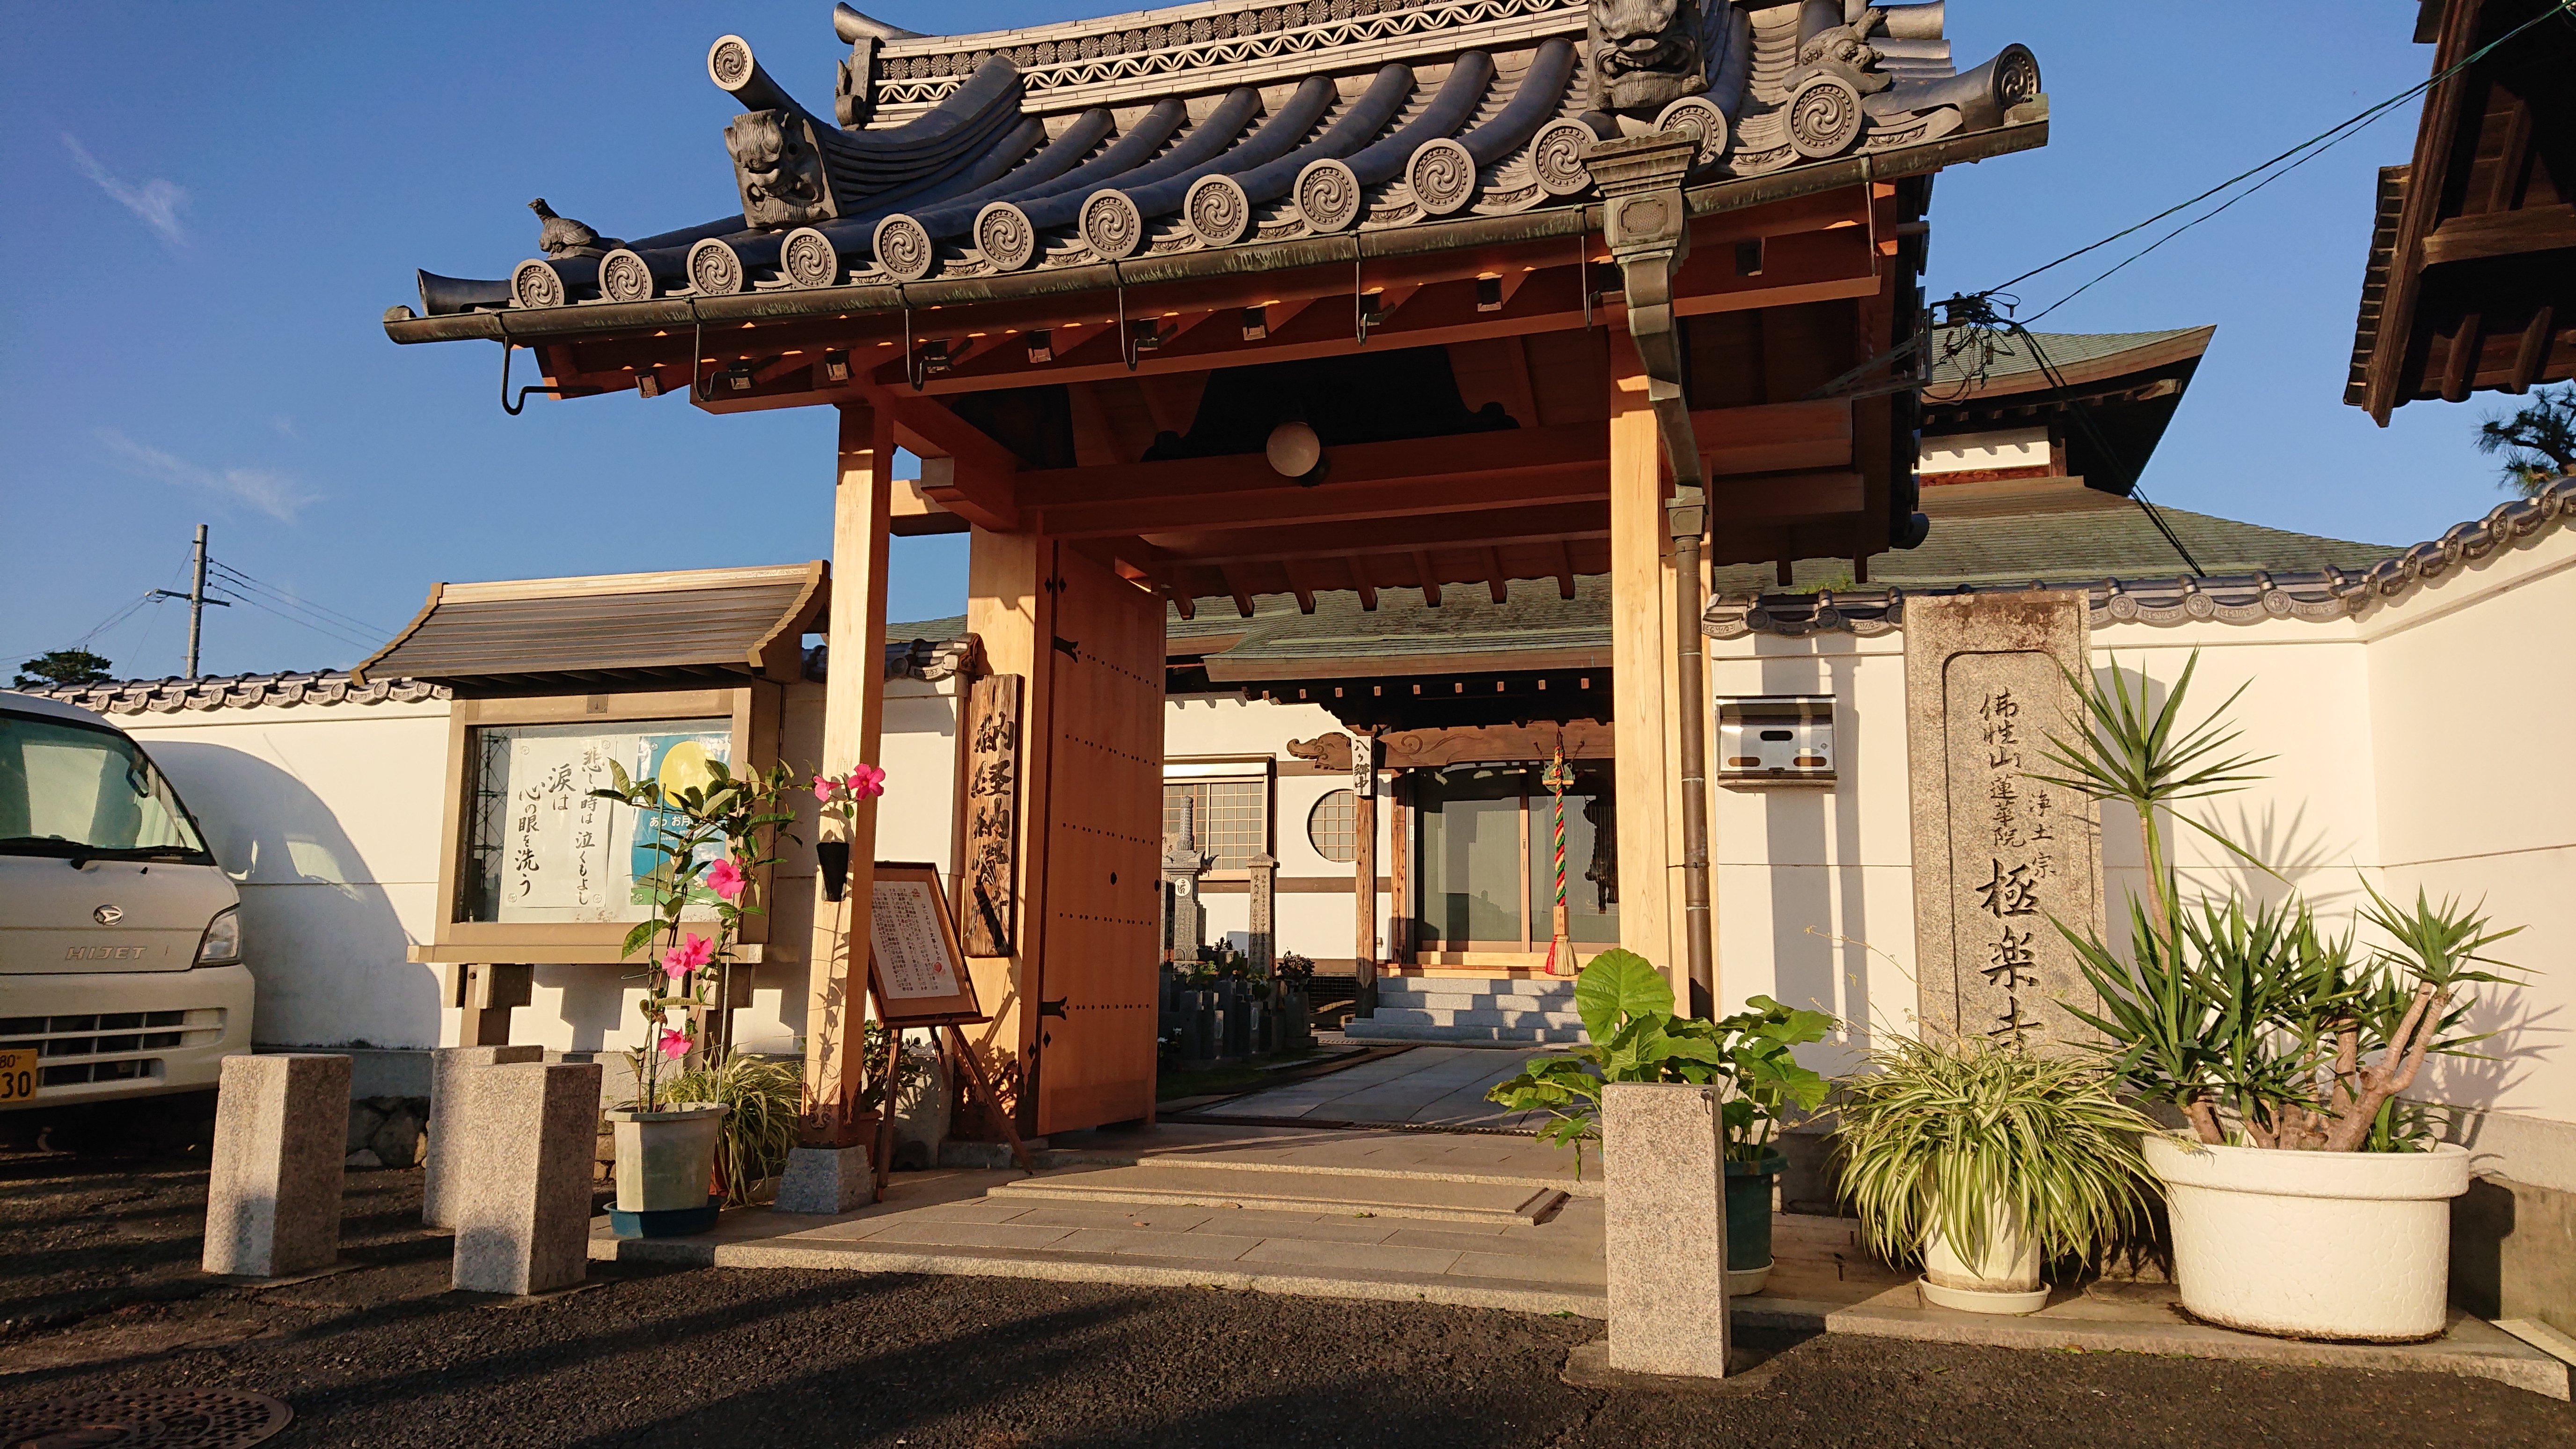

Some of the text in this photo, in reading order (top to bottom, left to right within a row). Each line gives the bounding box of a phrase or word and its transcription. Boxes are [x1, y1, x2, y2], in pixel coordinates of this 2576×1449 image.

[549, 763, 576, 811] 涙は
[515, 782, 546, 897] 心の眼を洗う
[2029, 790, 2056, 878] 浄土宗
[65, 946, 147, 960] HIJET
[1, 1070, 31, 1098] 30
